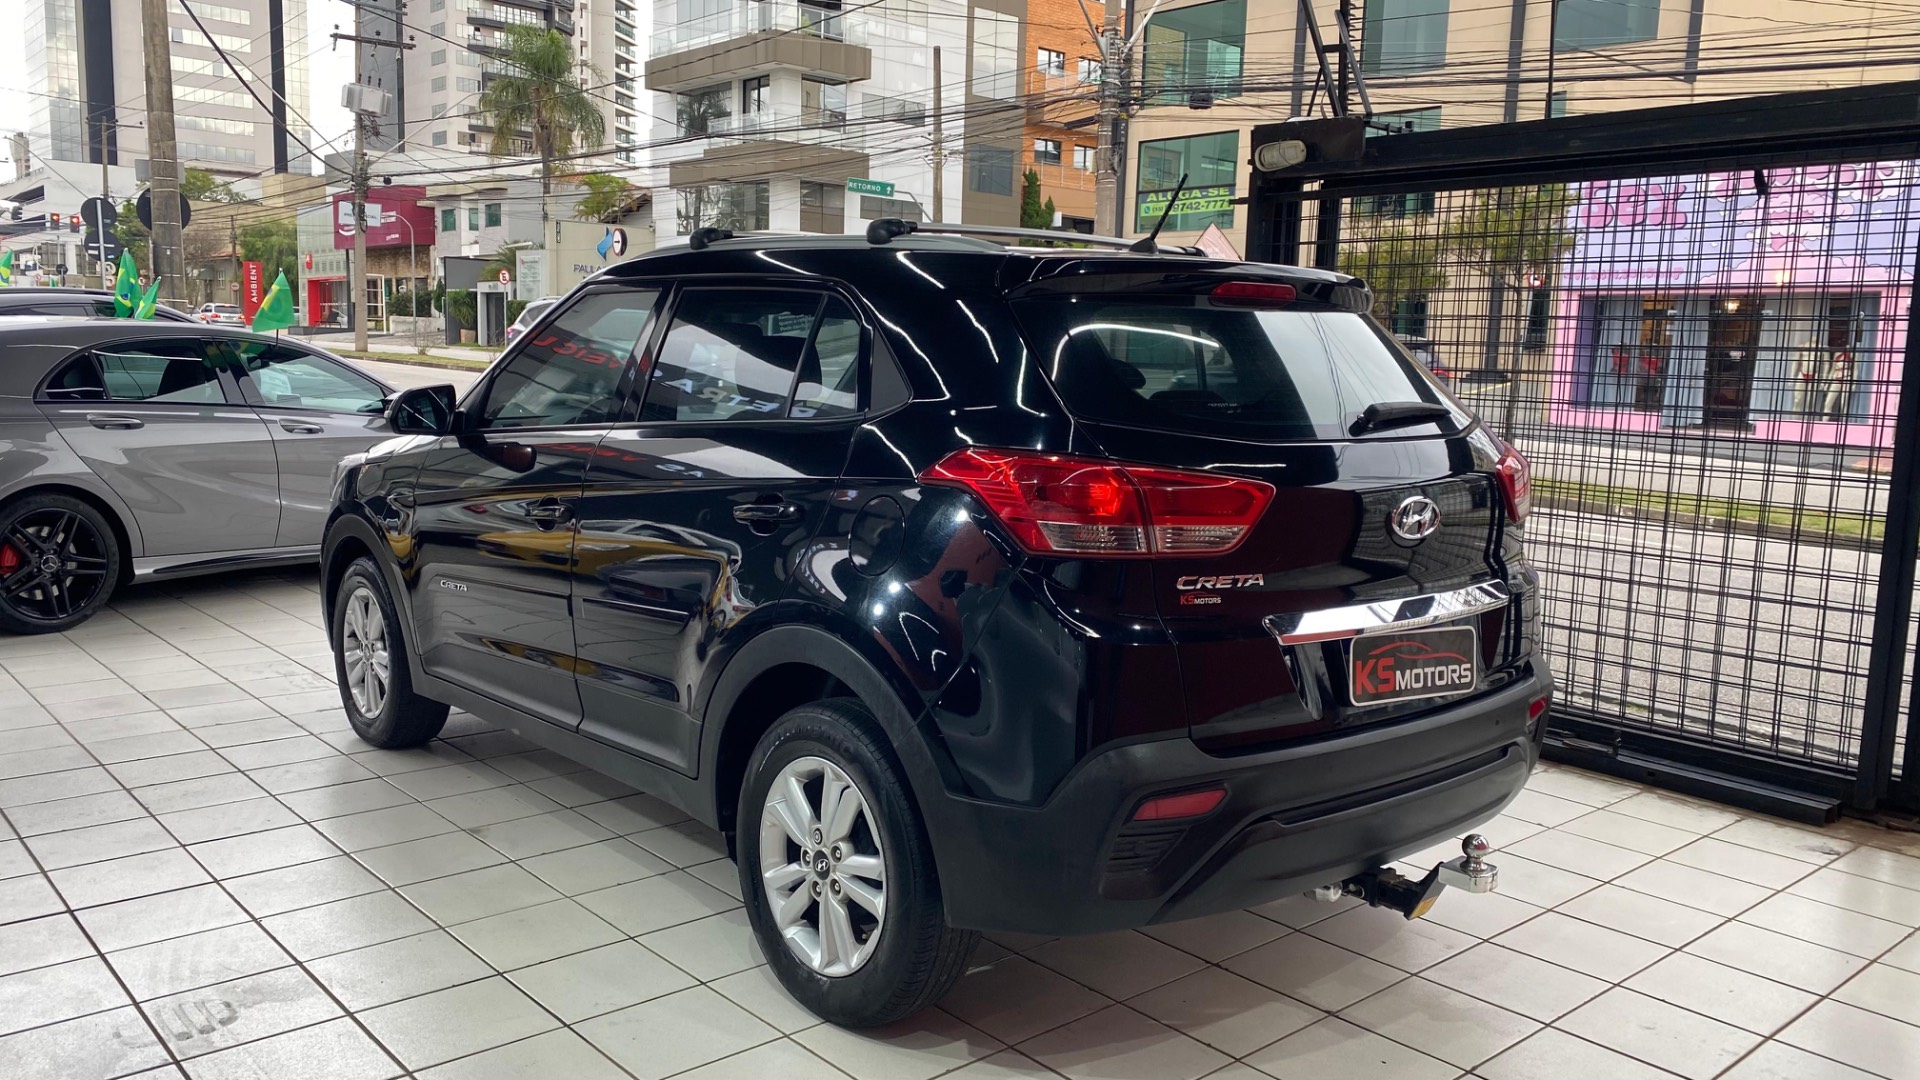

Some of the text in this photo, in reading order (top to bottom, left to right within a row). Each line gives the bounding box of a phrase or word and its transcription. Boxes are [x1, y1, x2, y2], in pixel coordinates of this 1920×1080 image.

[849, 182, 881, 191] RETORNO
[1147, 187, 1230, 202] ALUGA-SE
[250, 263, 258, 303] AMBIENT
[440, 580, 468, 592] CRETA
[1176, 573, 1264, 590] CRETA
[1395, 663, 1472, 691] MOTORS
